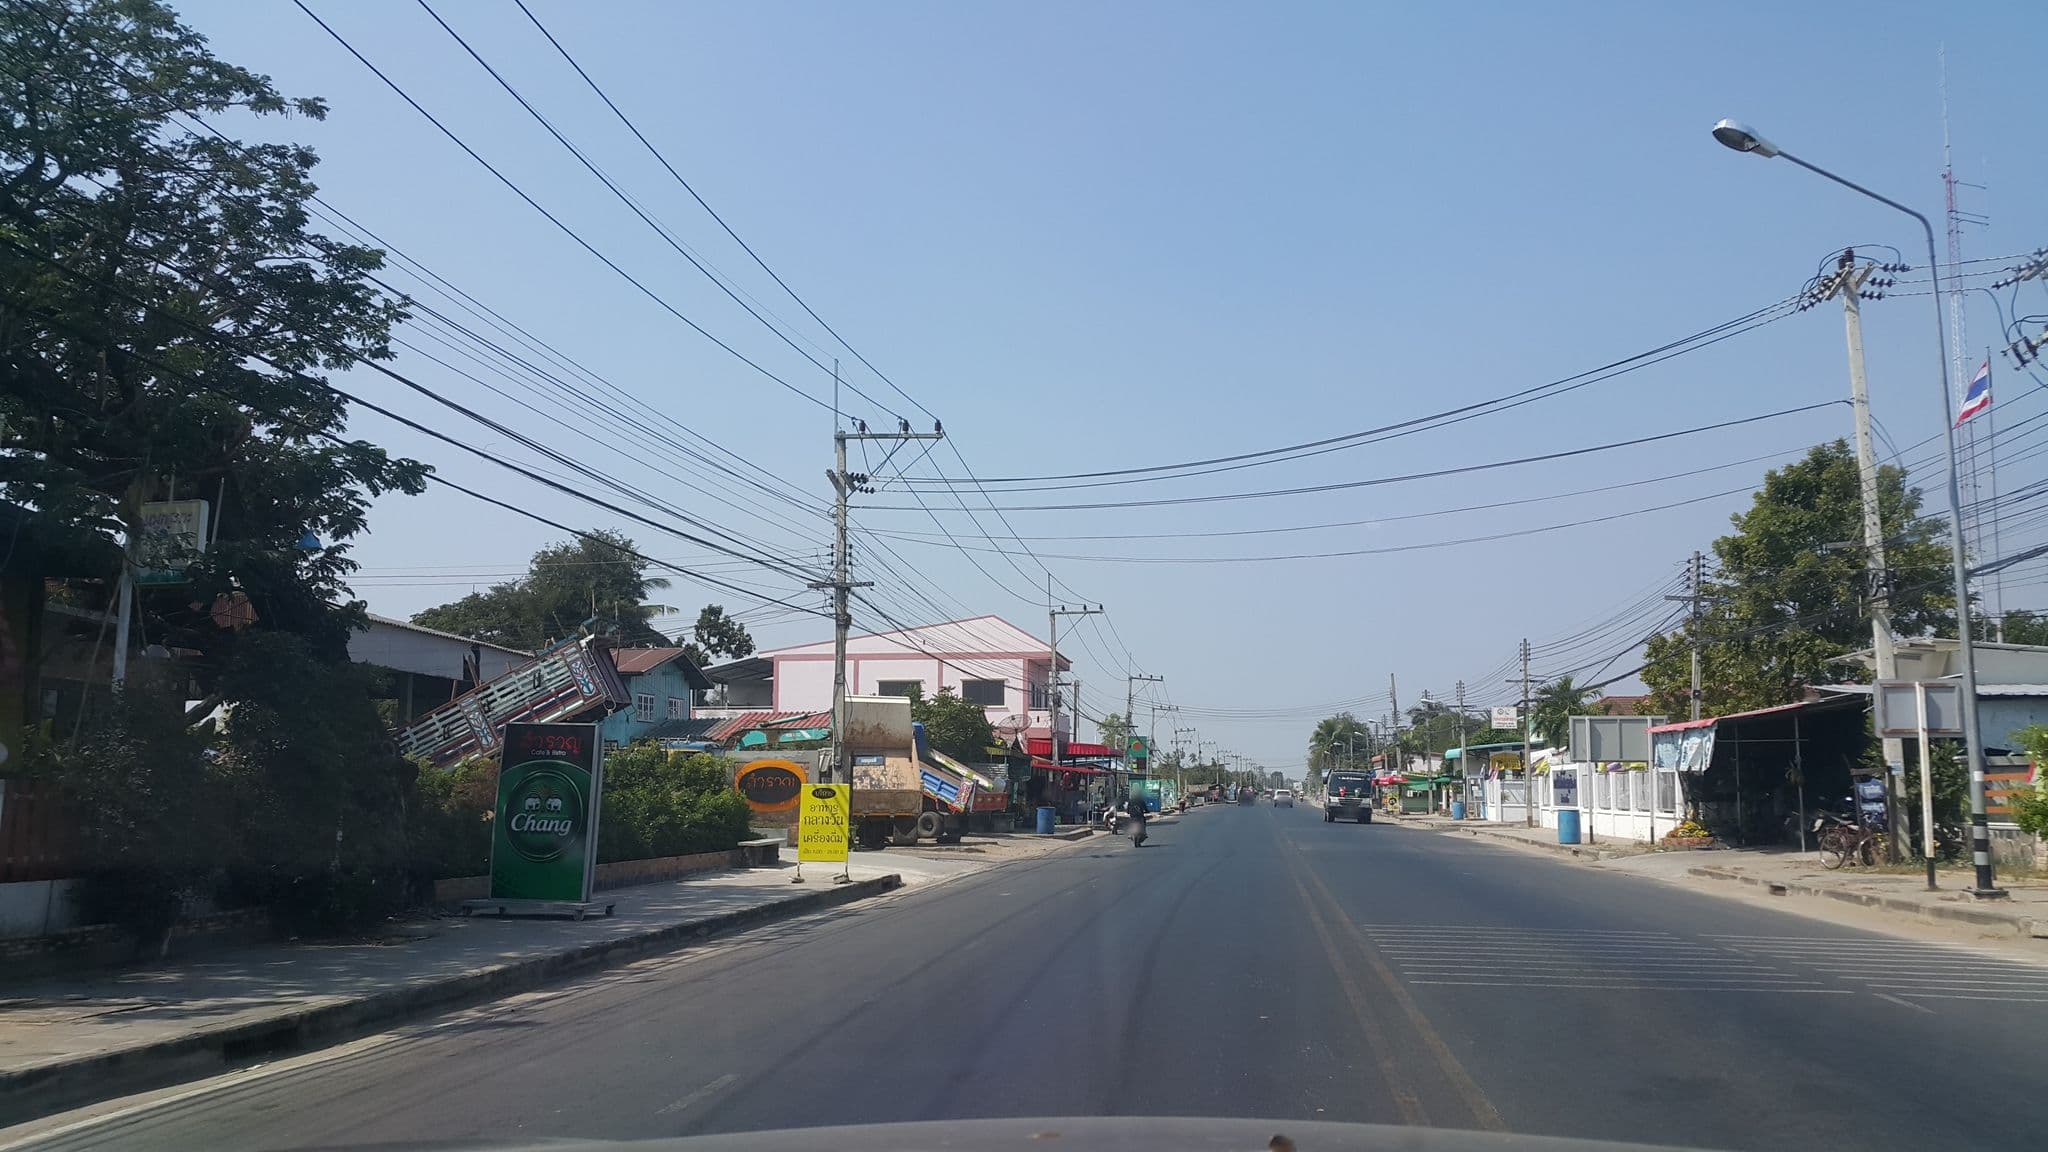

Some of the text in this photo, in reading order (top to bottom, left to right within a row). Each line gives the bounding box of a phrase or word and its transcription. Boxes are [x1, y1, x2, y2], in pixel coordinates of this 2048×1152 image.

[809, 804, 839, 813] อาหาร
[511, 813, 573, 837] Chang
[804, 812, 844, 825] กลางวัน
[803, 828, 843, 843] เครื่องดื่ม
